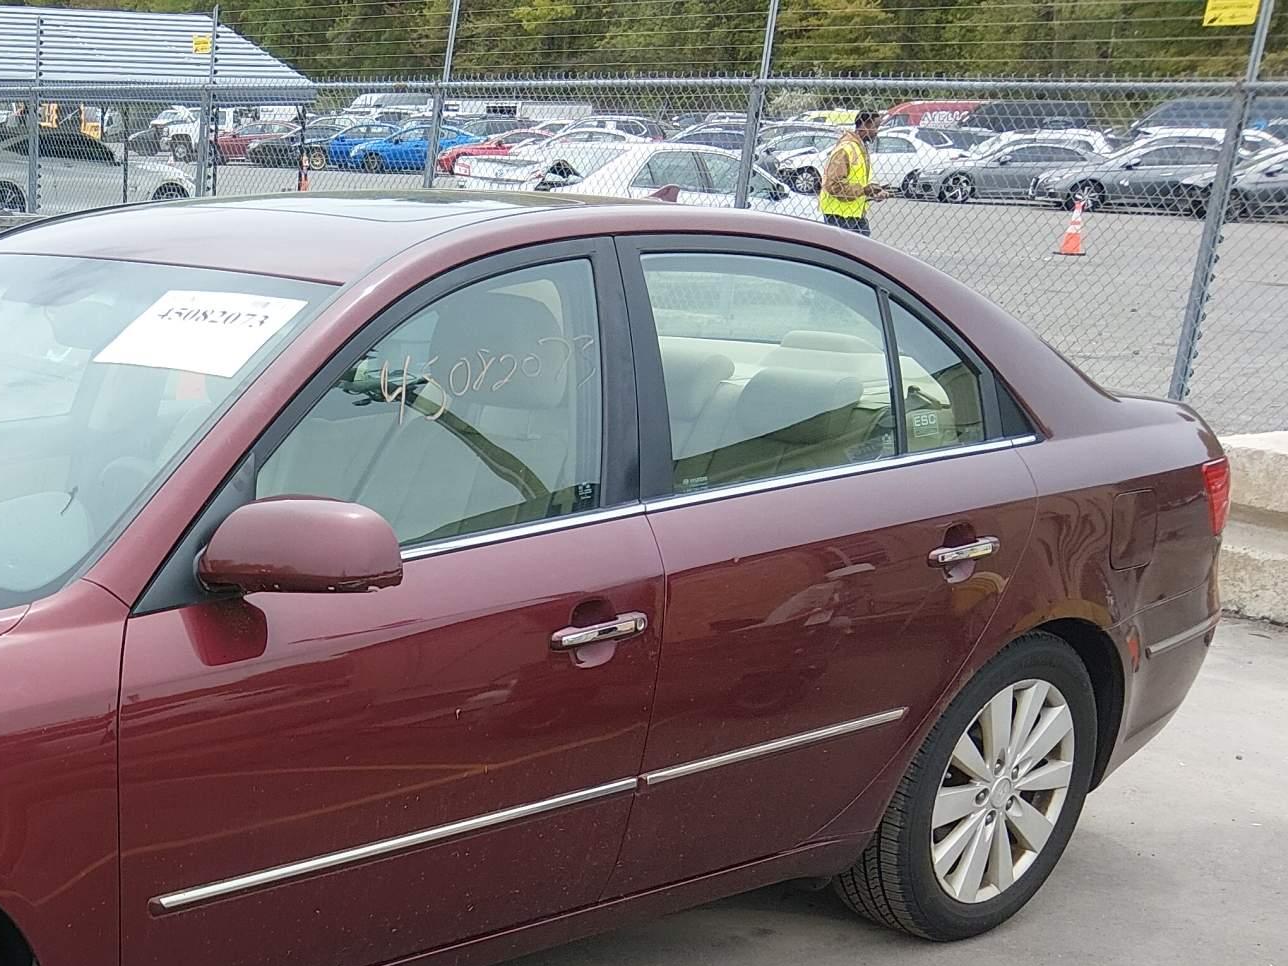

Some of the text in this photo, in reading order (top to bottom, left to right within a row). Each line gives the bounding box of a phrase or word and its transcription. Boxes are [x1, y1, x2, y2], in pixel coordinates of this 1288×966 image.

[158, 307, 269, 328] 45082073
[380, 334, 596, 425] 45082073
[913, 413, 937, 427] ESC
